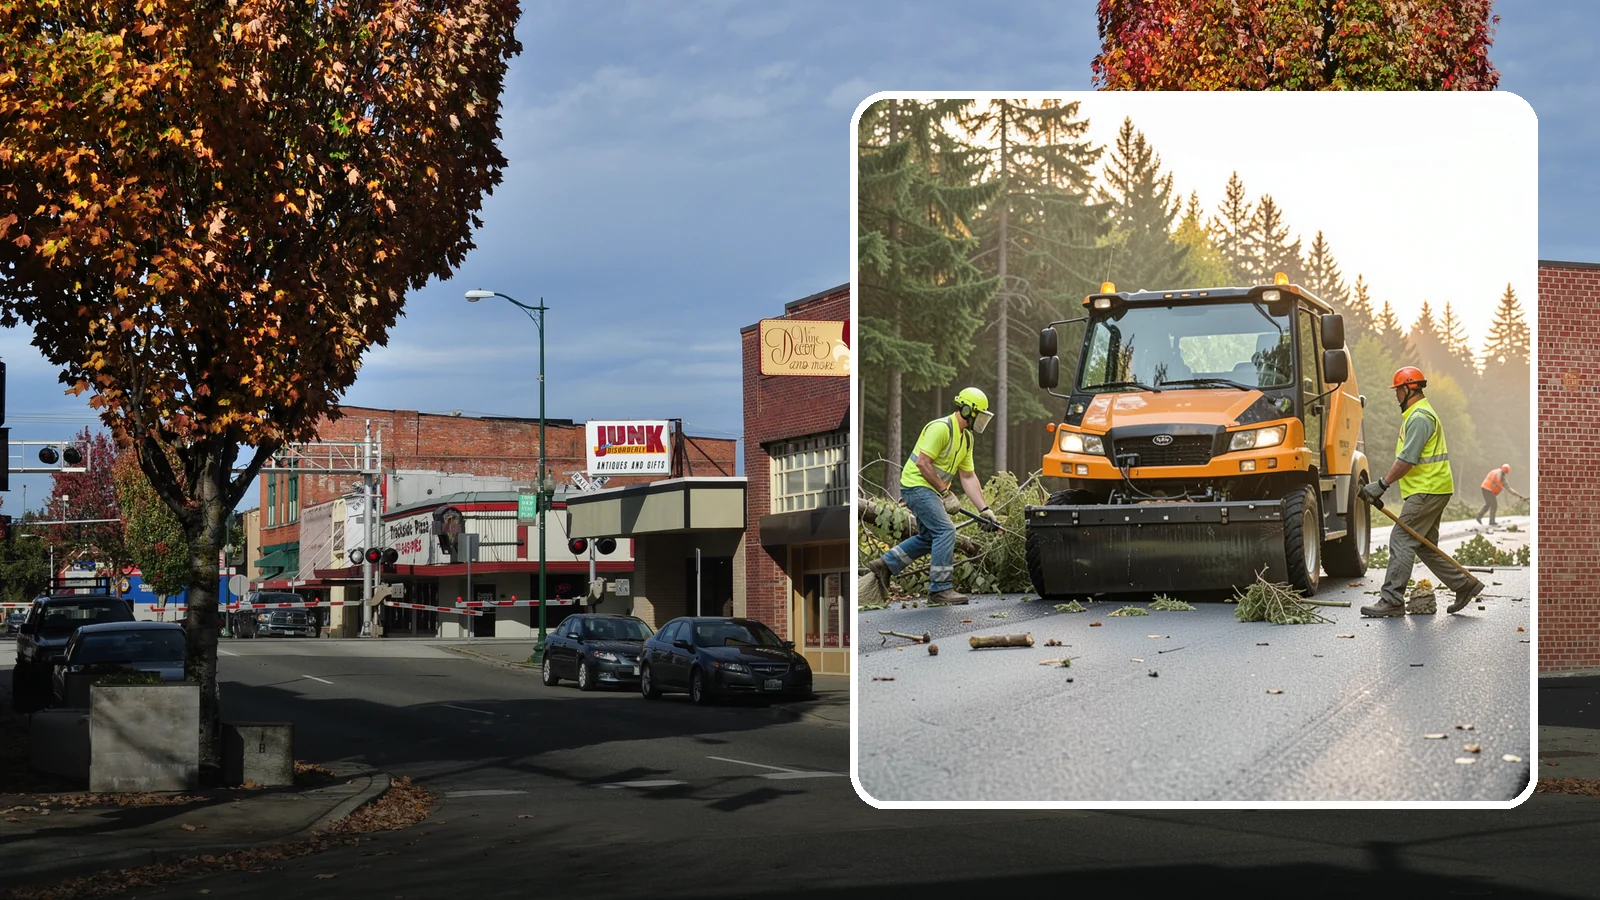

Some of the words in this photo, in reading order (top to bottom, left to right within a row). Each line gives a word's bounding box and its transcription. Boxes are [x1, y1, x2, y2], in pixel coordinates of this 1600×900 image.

[596, 425, 664, 457] JUNK
[607, 446, 646, 454] DISORDERLY
[597, 461, 628, 470] ANTIQUES
[631, 461, 643, 470] AND
[647, 460, 665, 469] GIFTS
[414, 519, 429, 534] Pizza
